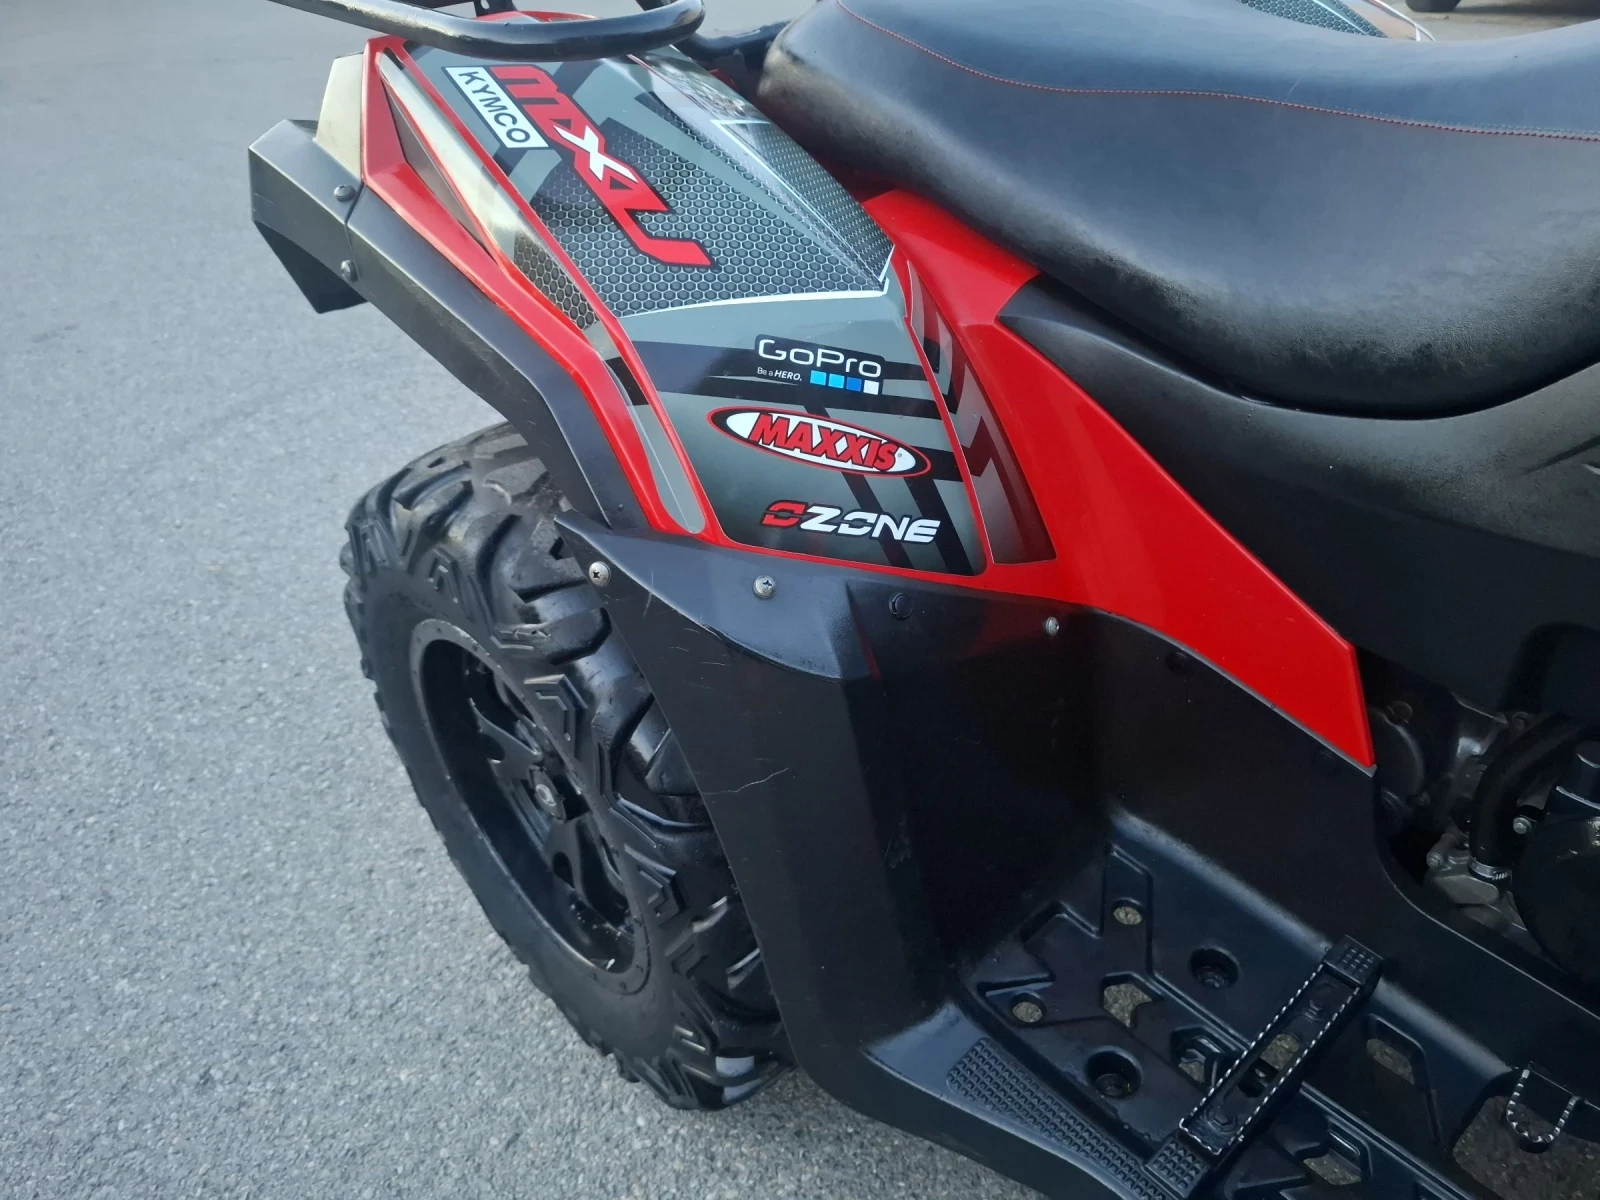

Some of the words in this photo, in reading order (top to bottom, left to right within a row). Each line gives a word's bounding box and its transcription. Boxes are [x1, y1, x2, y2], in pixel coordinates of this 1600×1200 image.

[457, 70, 532, 145] KYMCO
[757, 366, 768, 376] Be
[774, 369, 802, 381] HERO.
[758, 338, 882, 378] GoPro
[748, 413, 898, 472] MAXXIS
[761, 501, 942, 544] OZONE
